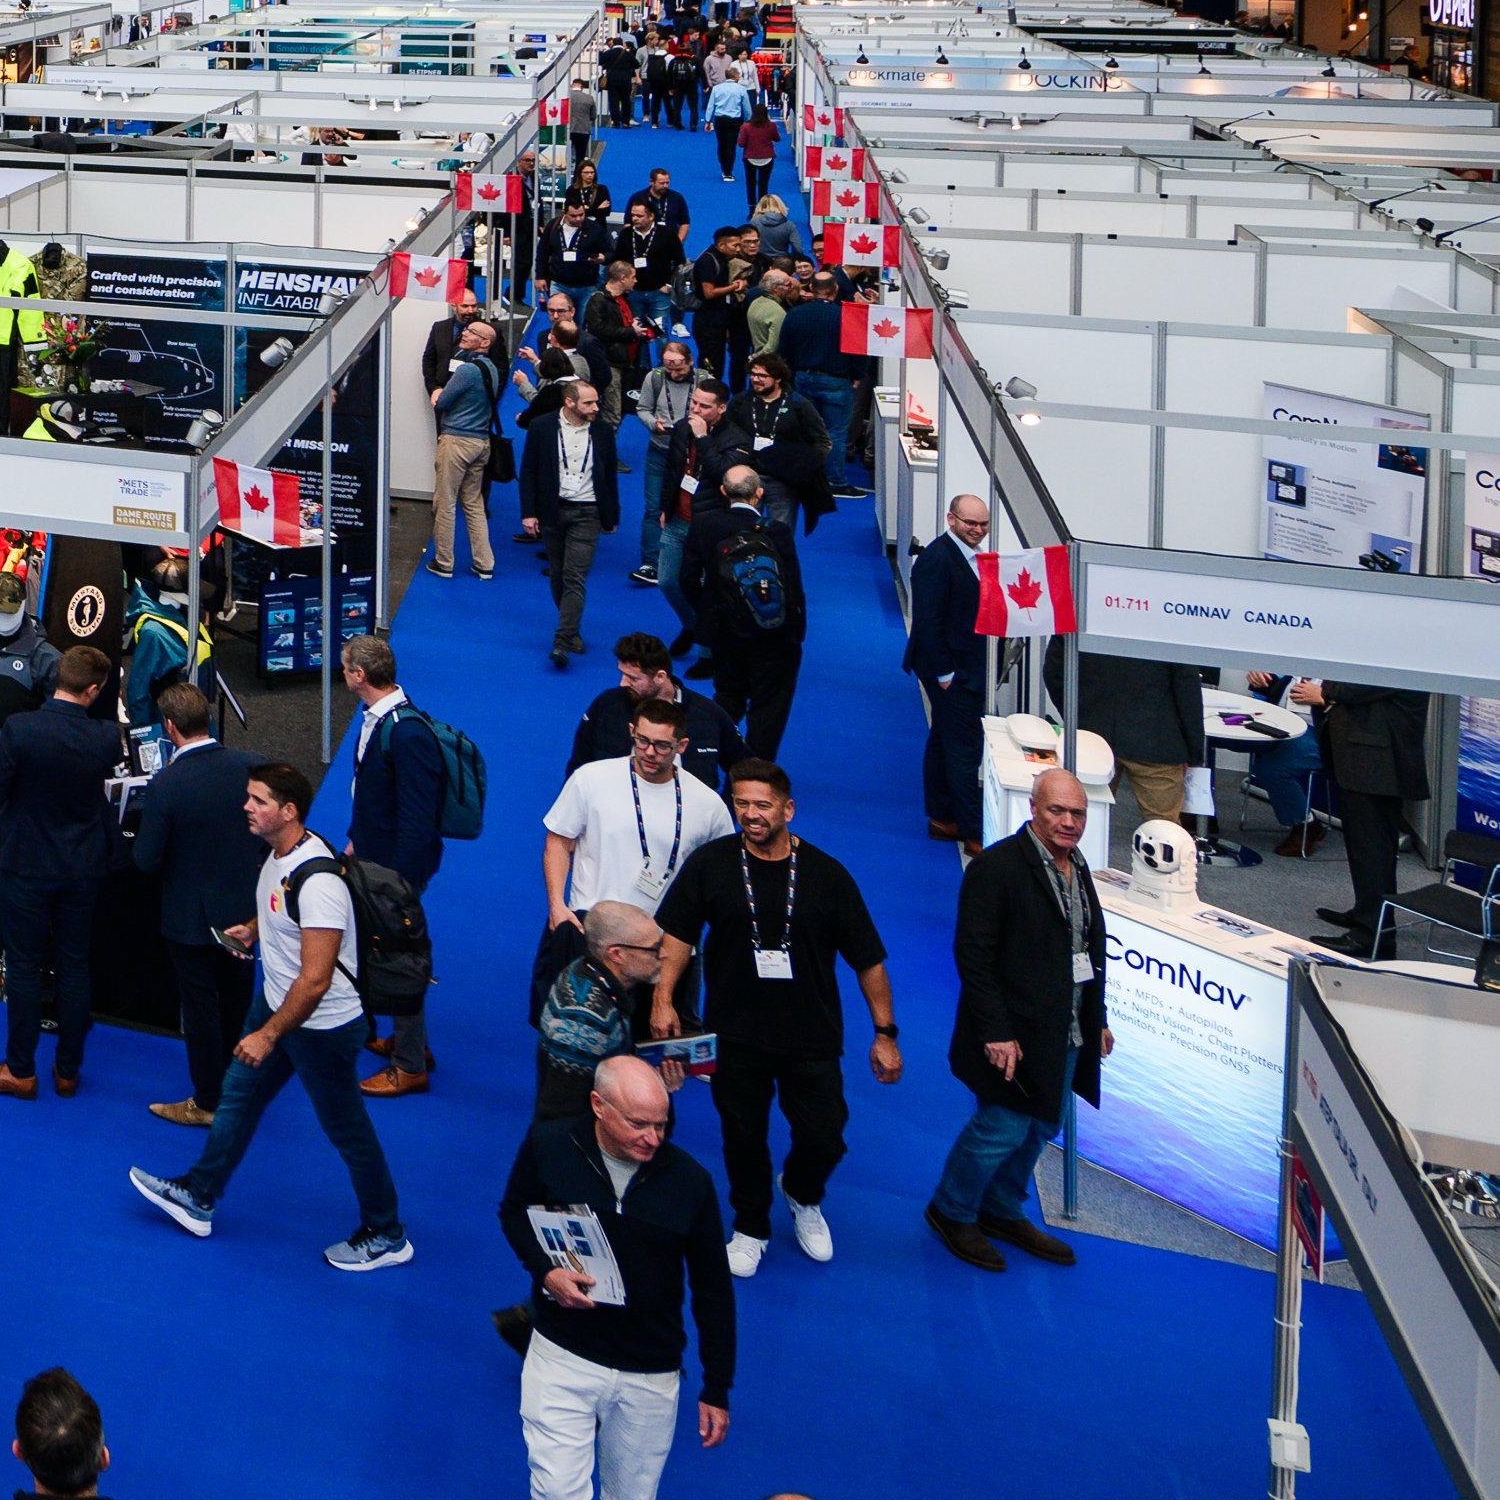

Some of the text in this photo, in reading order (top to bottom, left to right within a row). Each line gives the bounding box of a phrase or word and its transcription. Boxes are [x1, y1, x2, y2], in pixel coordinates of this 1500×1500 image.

[91, 270, 221, 290] Crafted with precision
[91, 285, 195, 299] and consideration
[238, 292, 320, 310] INFLATABL
[120, 486, 148, 497] TRADE
[123, 478, 148, 488] METS
[116, 510, 172, 522] DAME ROUTE
[116, 517, 173, 529] NOMINATION
[1106, 596, 1313, 629] 01.711 COMNAV CANADA
[1106, 934, 1246, 1011] ComNav
[1135, 987, 1233, 1037] MFDs Autopilots
[1111, 1006, 1250, 1075] Monitors Precision GNSS
[1132, 1002, 1283, 1074] Night Vision Chart Plotters
